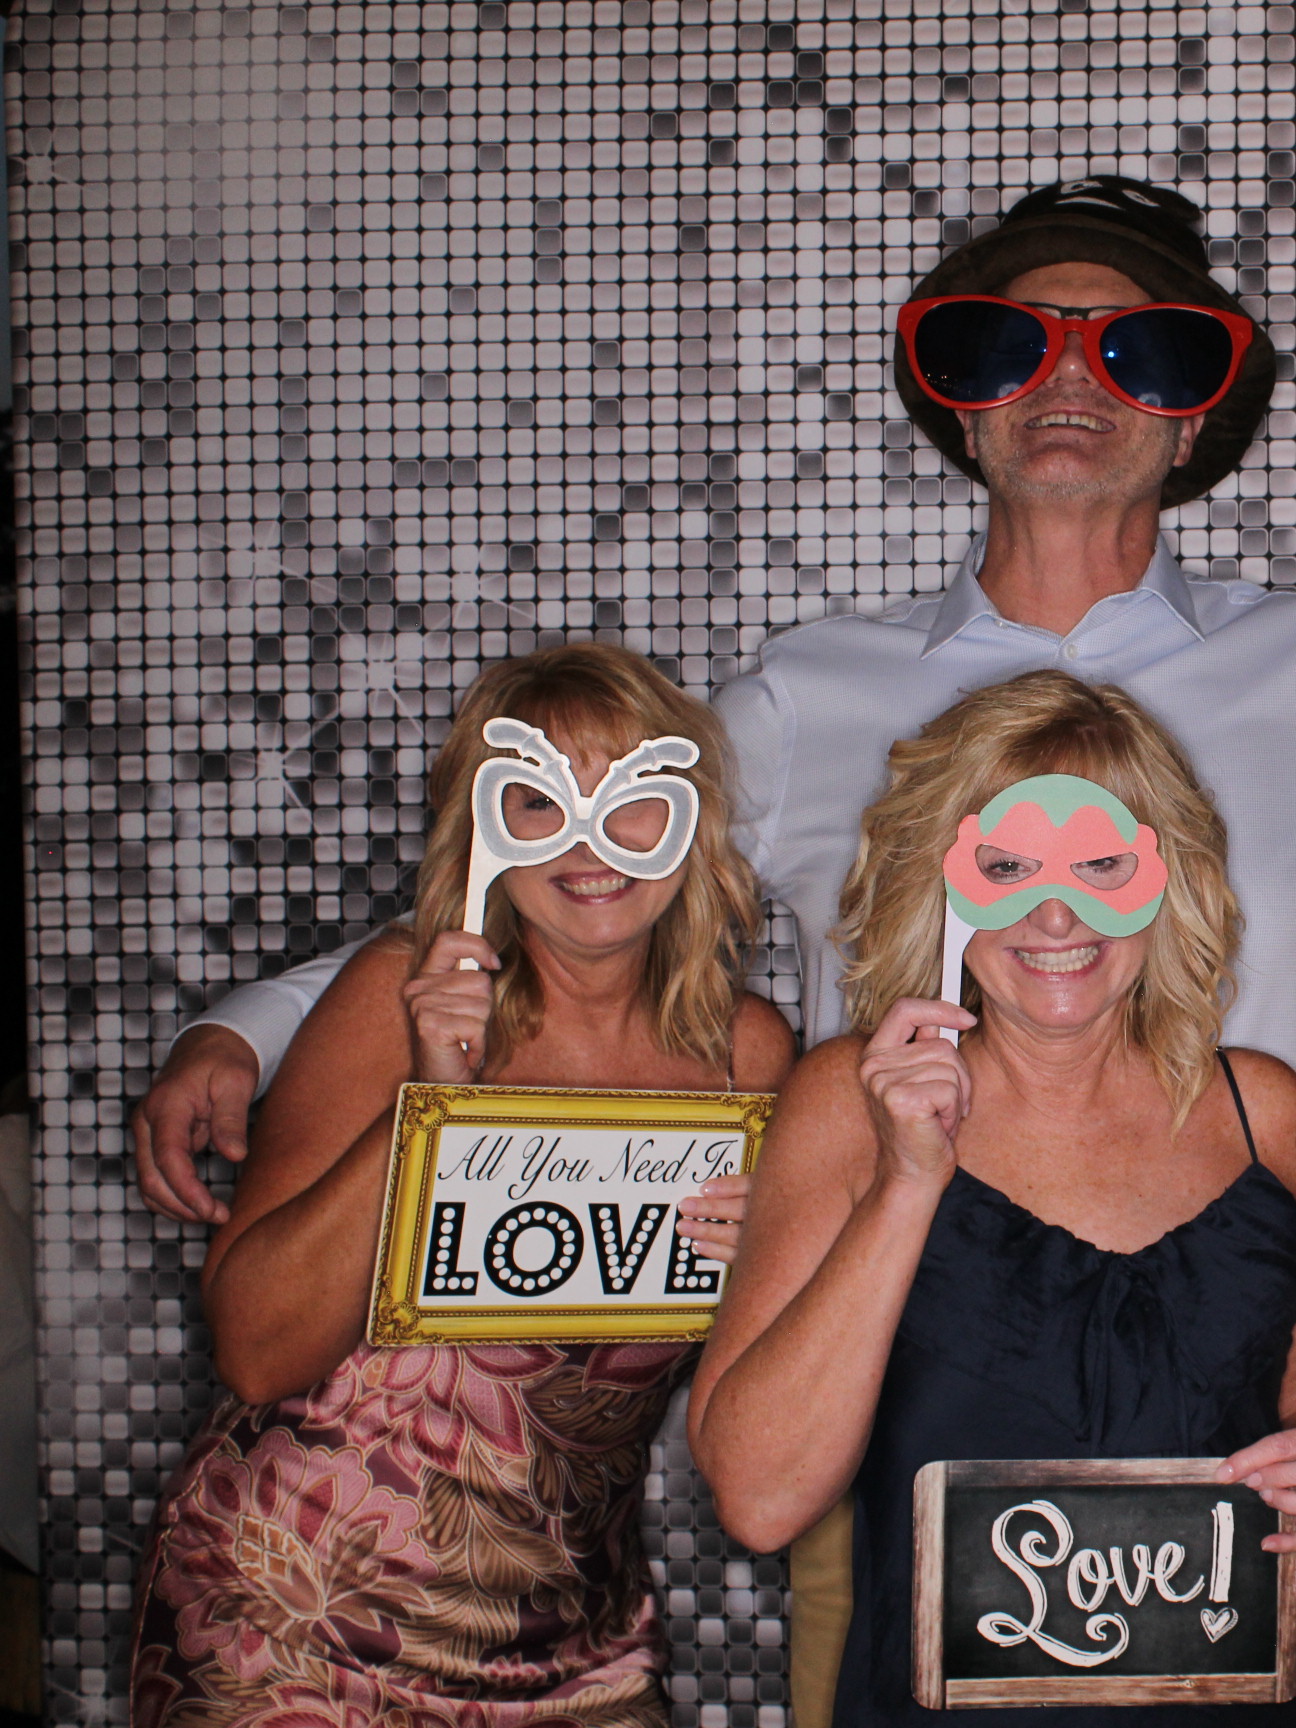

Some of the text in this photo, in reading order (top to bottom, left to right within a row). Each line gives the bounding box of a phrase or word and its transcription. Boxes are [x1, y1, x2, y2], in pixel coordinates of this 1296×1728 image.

[438, 1134, 740, 1200] All You Need Is
[976, 1499, 1238, 1667] Love!
